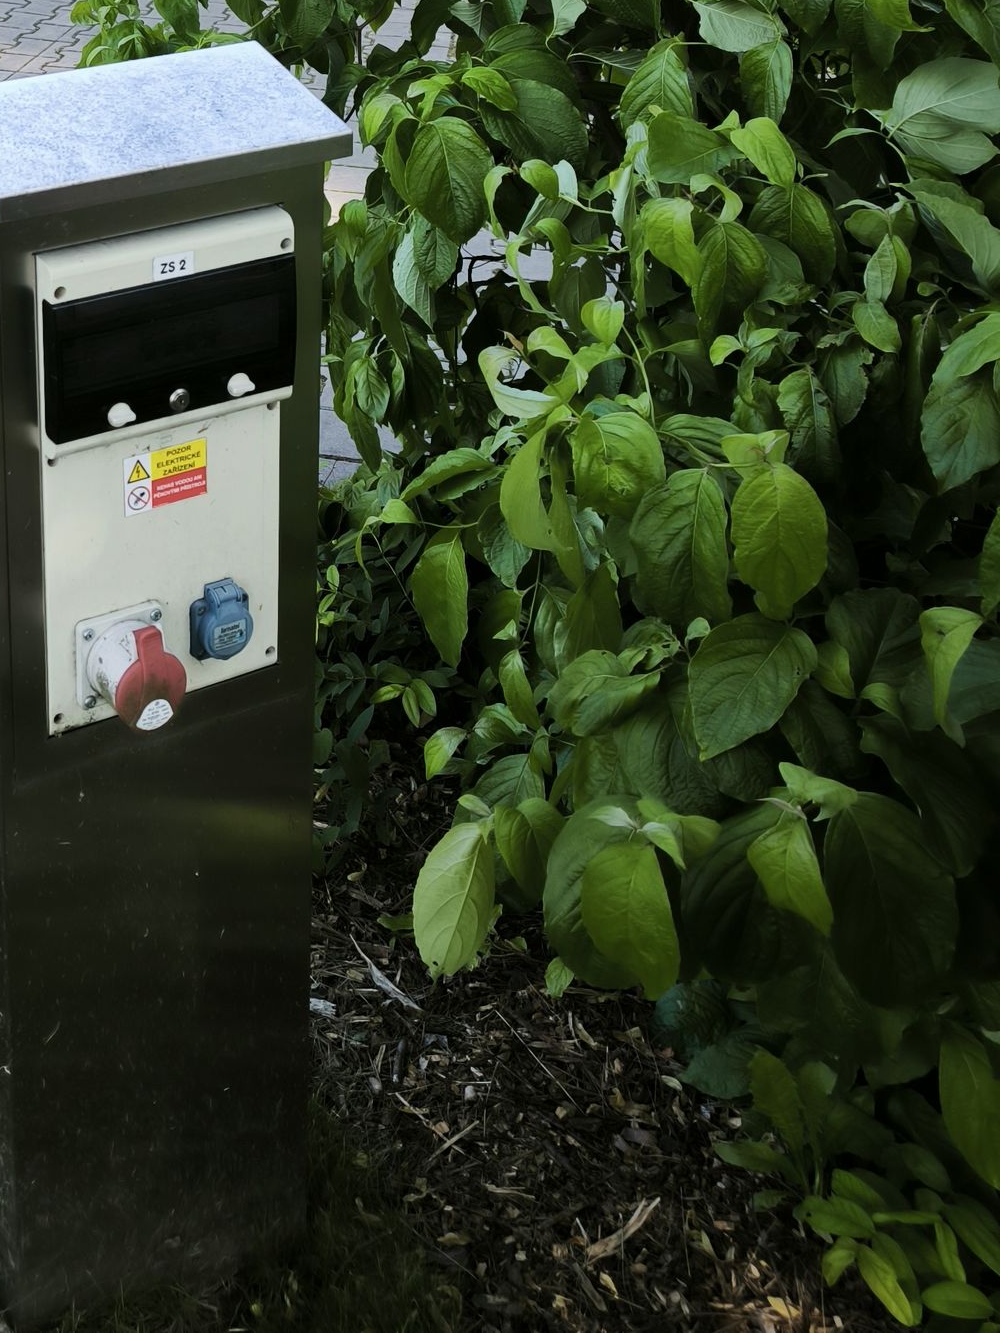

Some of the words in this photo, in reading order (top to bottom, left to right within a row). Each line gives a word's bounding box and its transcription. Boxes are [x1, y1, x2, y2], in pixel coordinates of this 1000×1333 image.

[160, 261, 176, 275] ZS
[179, 259, 186, 271] 2
[166, 445, 192, 457] POZOR
